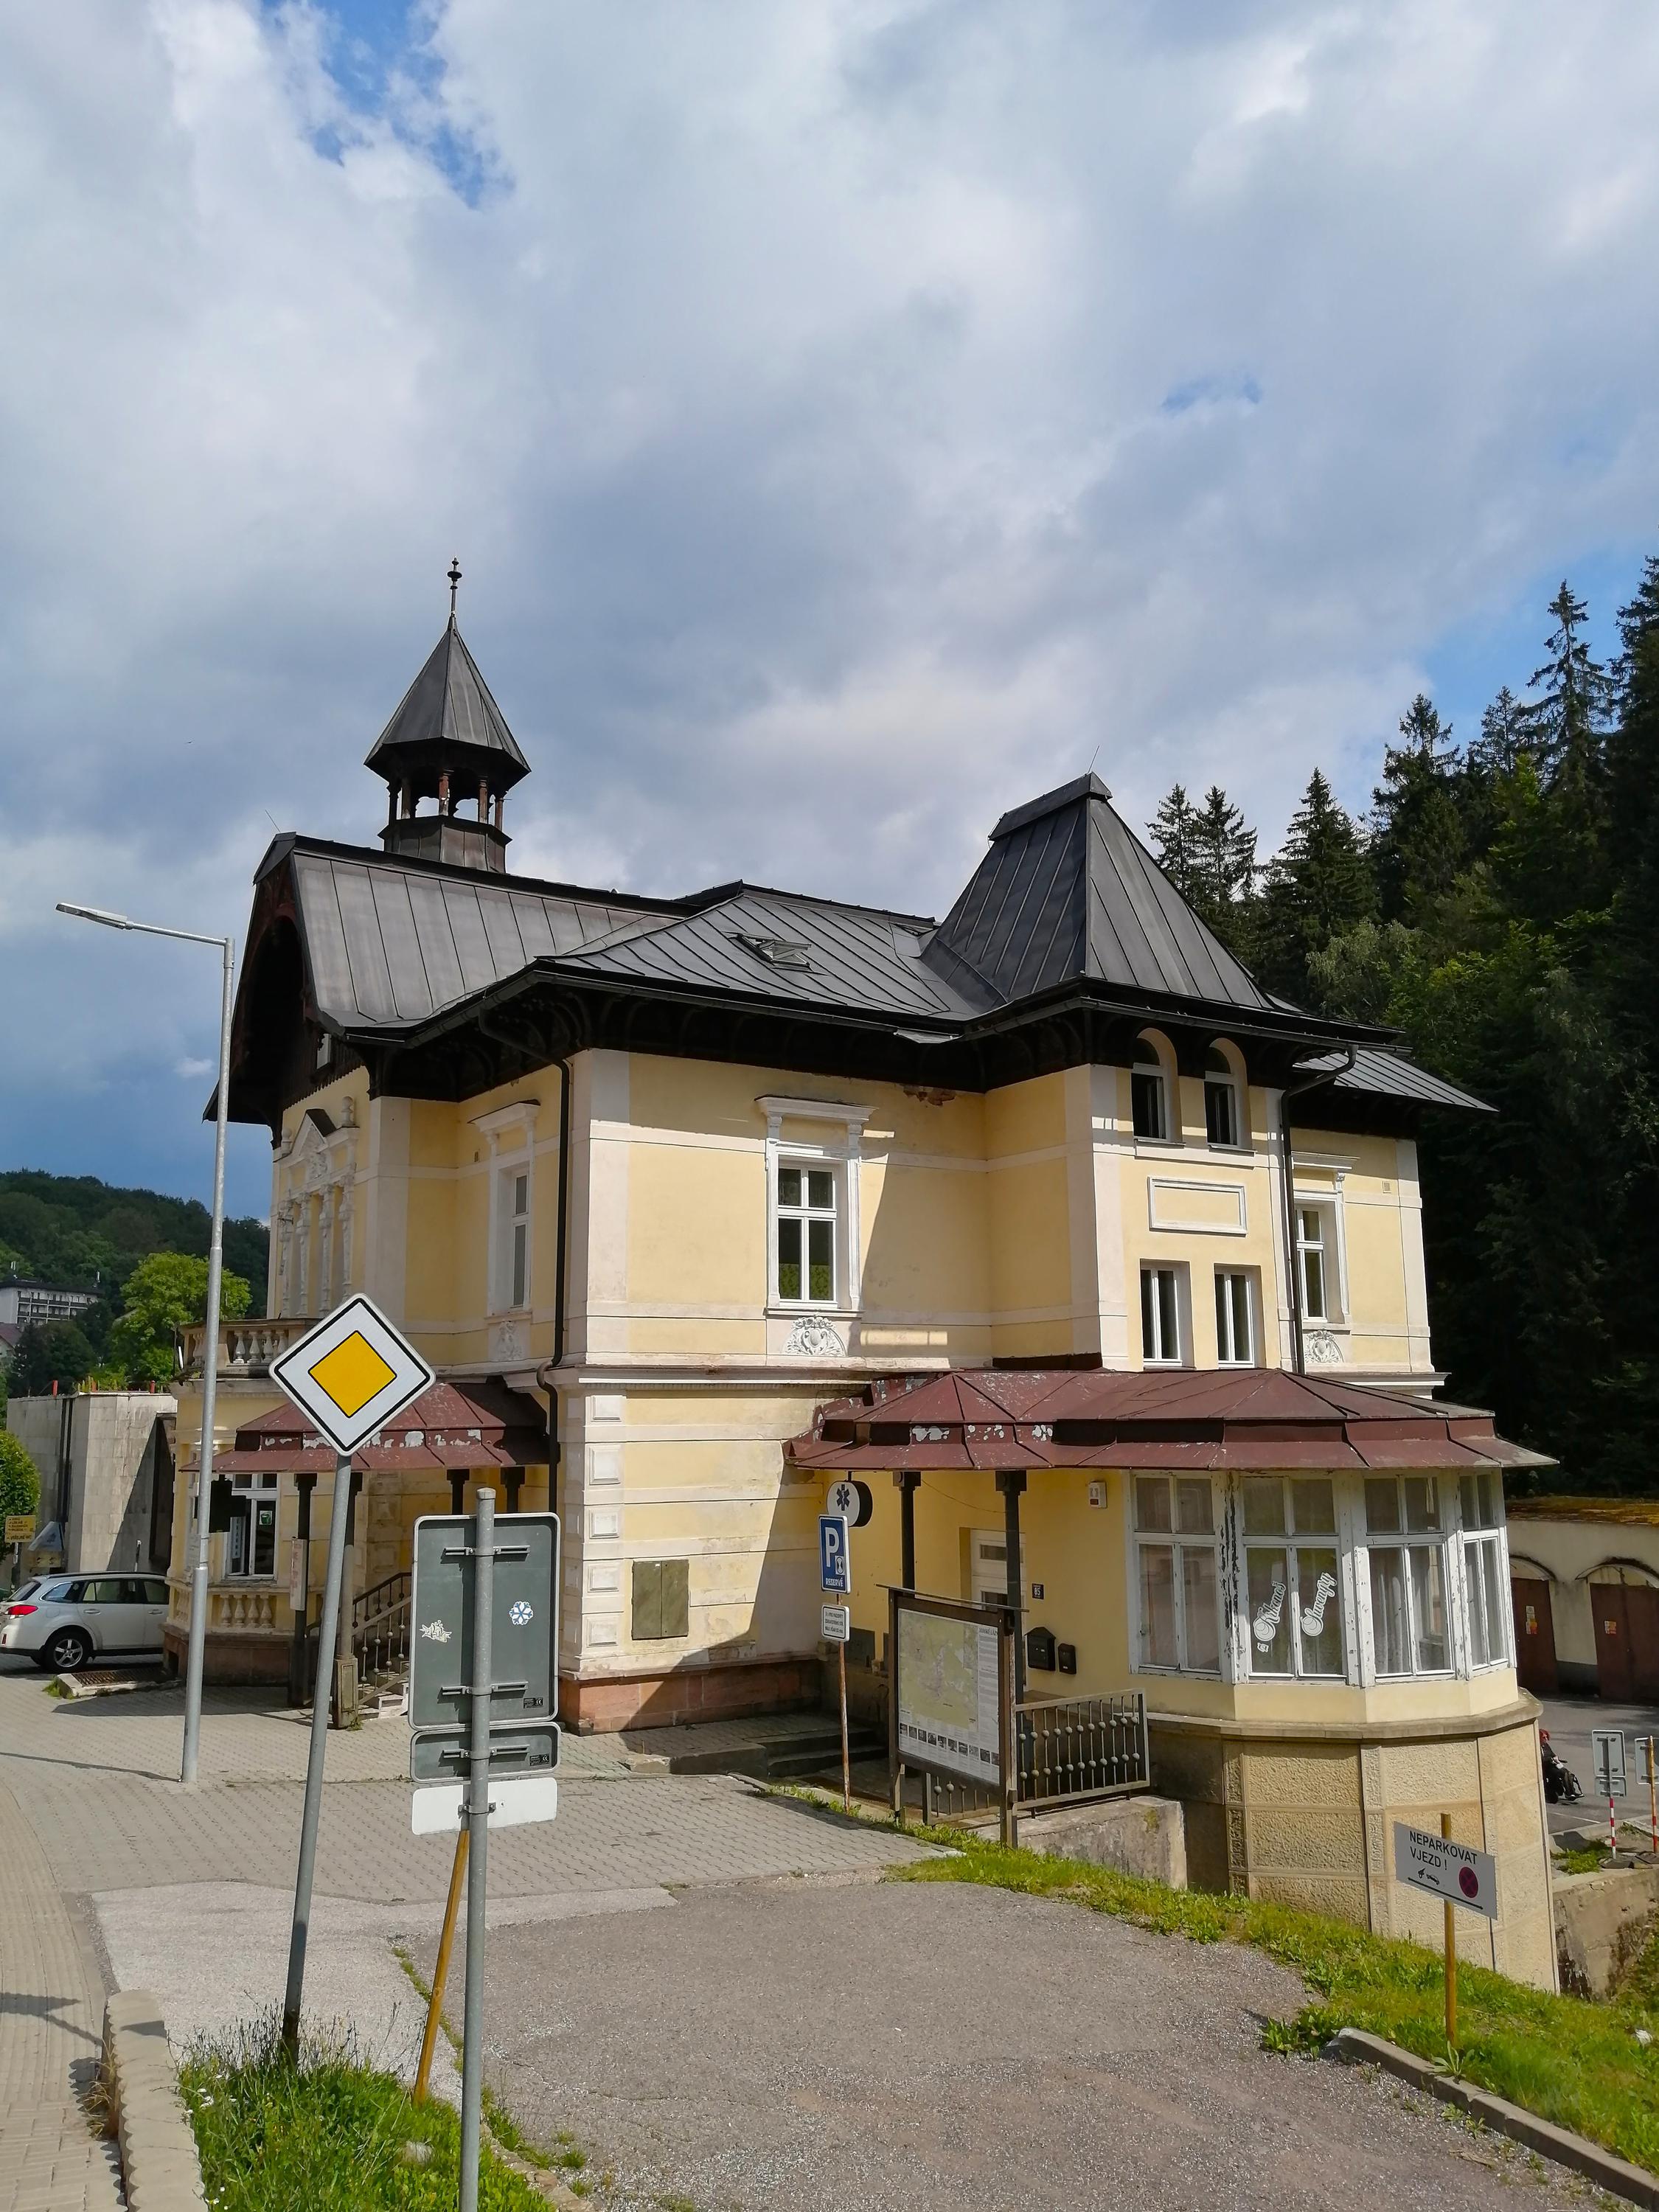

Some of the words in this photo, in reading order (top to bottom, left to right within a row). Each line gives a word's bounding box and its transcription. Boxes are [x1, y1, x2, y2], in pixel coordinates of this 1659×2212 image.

[825, 1526, 839, 1568] P
[1409, 1830, 1478, 1865] NEPARKOVAT
[1410, 1846, 1441, 1868] VJEZD
